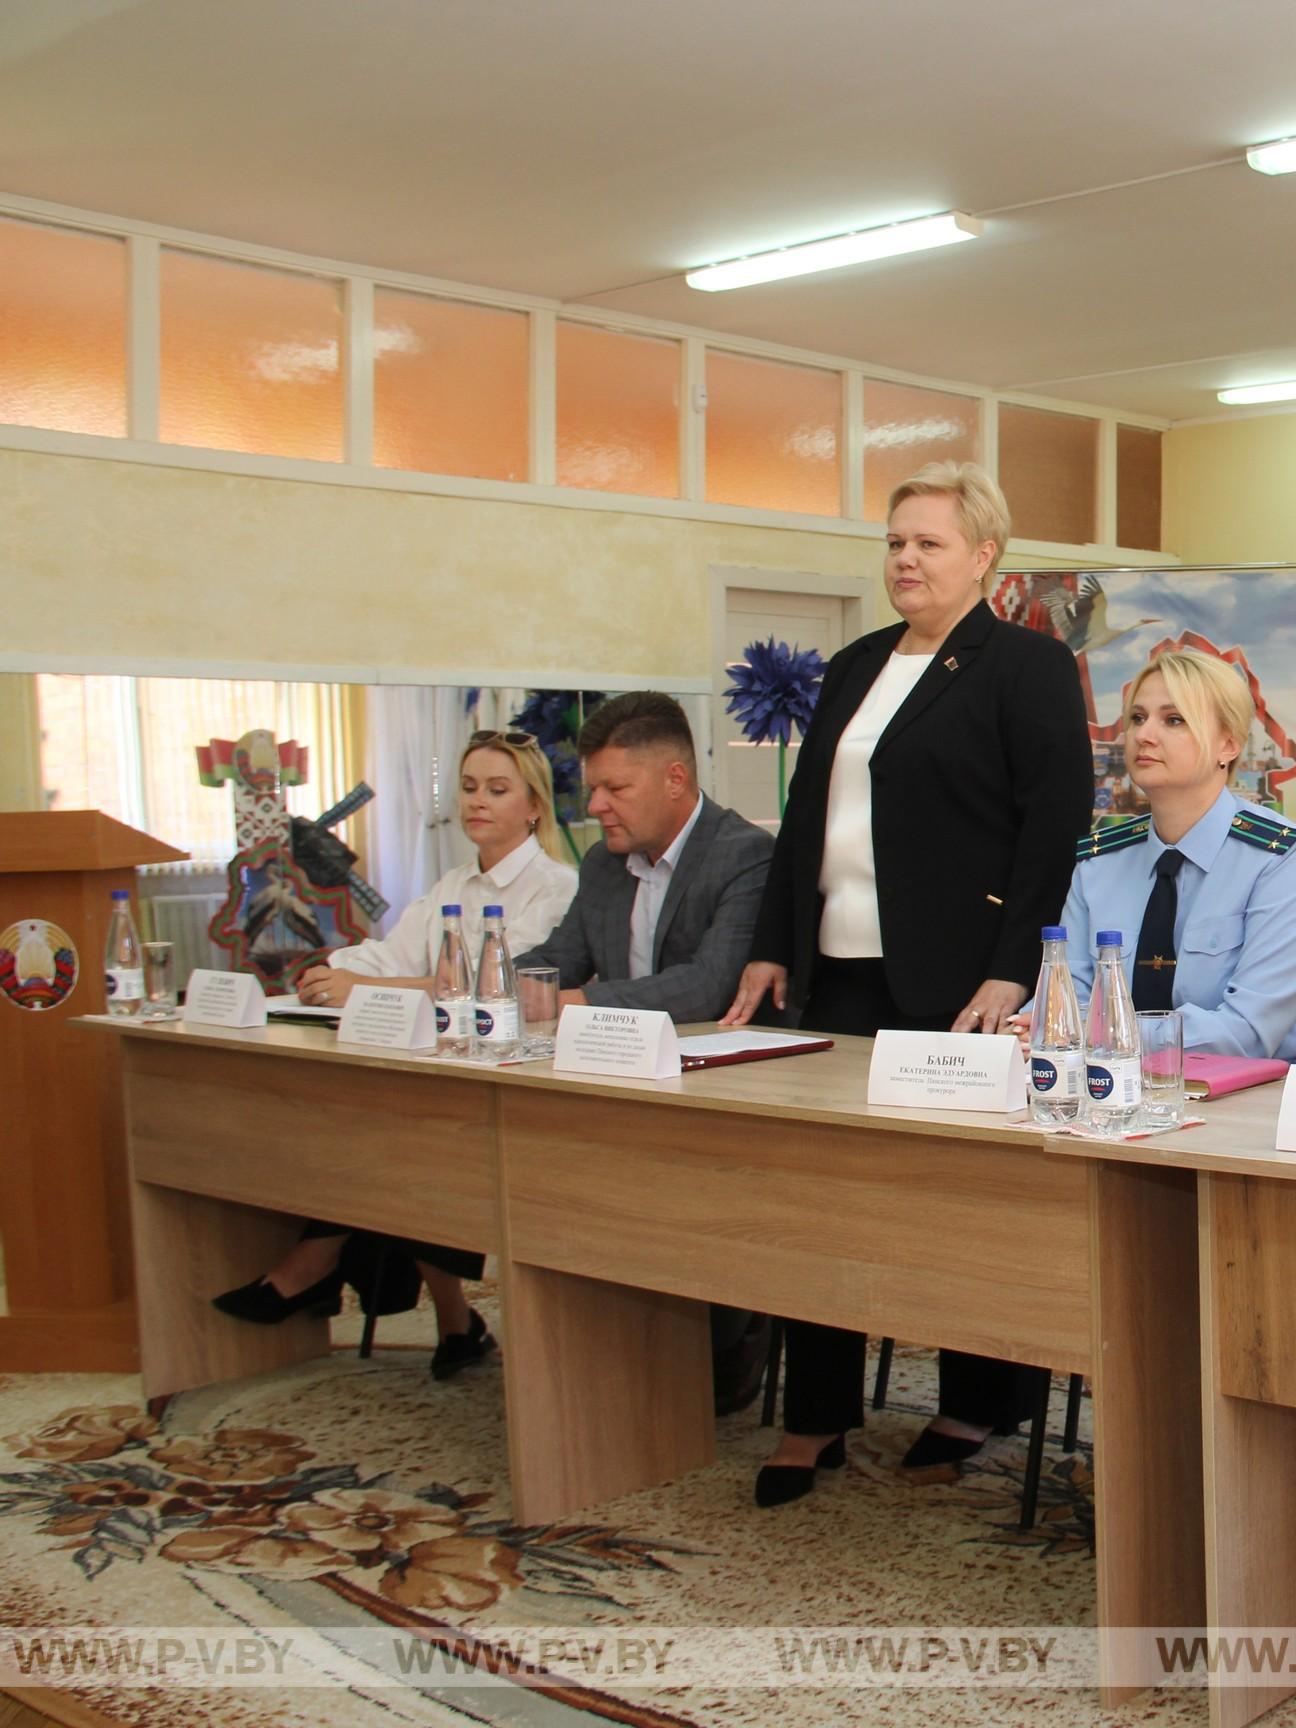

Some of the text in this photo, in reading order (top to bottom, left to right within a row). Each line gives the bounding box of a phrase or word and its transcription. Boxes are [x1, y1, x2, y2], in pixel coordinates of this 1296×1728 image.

[592, 1012, 639, 1025] КЛИМЧУК
[927, 1055, 965, 1067] БАБИЧ
[899, 1066, 988, 1079] ЕКАТЕРИНА ЭДУАРДОВНА
[1032, 1069, 1055, 1079] FROST
[1088, 1077, 1111, 1087] FROST
